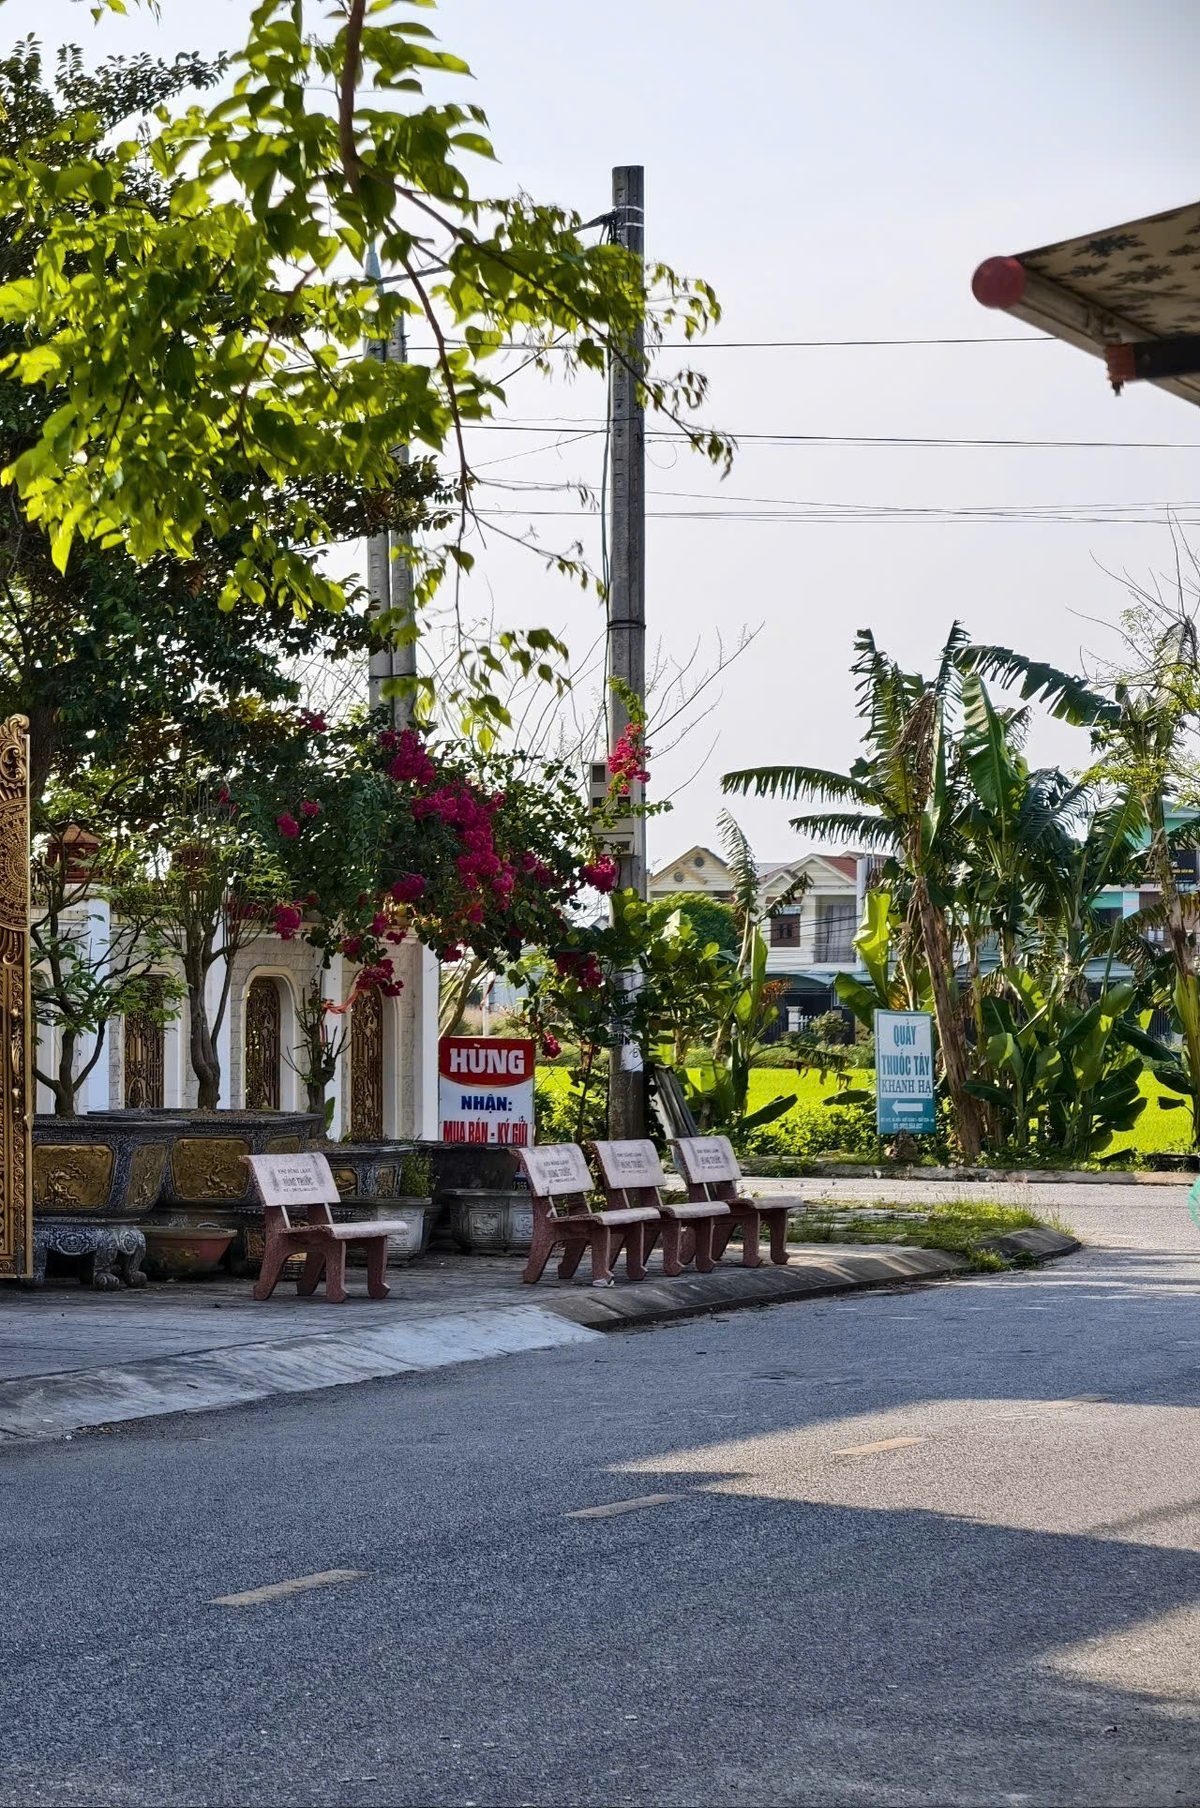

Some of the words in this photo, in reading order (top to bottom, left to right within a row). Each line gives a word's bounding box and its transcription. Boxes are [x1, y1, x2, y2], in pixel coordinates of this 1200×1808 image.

[449, 1043, 525, 1075] HÙNG
[881, 1049, 911, 1075] THUỐC
[914, 1052, 930, 1075] TÂY
[881, 1079, 915, 1093] KHANH
[918, 1079, 932, 1097] HẠ
[461, 1093, 513, 1114] NHẬN:
[443, 1120, 466, 1143] MUA
[468, 1117, 489, 1143] BÁN
[497, 1118, 510, 1143] KÝ
